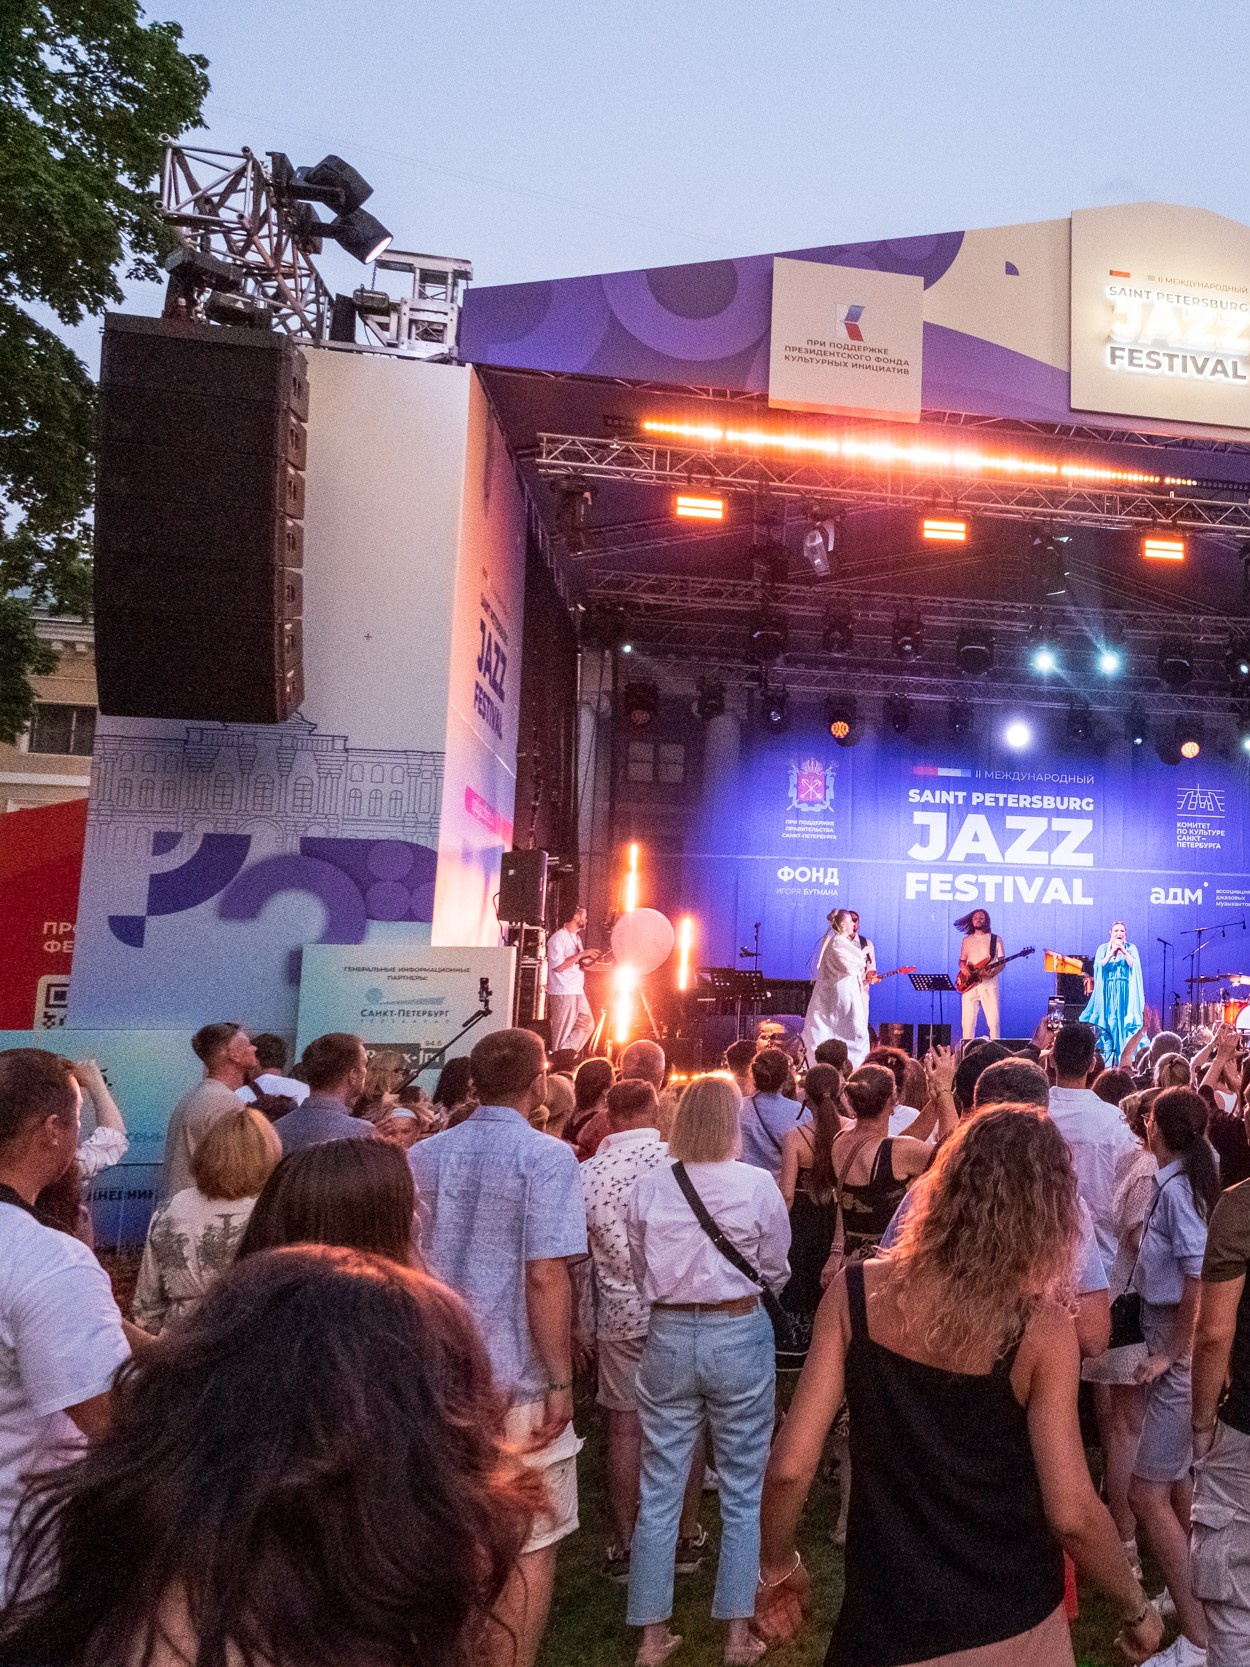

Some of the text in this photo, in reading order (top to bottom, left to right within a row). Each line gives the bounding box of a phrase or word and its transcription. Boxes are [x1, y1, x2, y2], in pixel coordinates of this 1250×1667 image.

[1165, 277, 1248, 294] МЕЖДУНАРОДНЫЙ
[1109, 286, 1249, 312] SAINT PETERSBURG
[784, 345, 910, 367] ПРЕЗИДЕНТСКОГО ФОНДА
[806, 339, 889, 355] ПРИ ПОДДЕРЖКЕ
[784, 354, 910, 375] КУЛЬТУРНЫХ ИНИЦИАТИВ
[1109, 346, 1247, 380] FESTIVAL
[985, 770, 1095, 784] МЕЖДУНАРОДНЫЙ
[908, 789, 1094, 811] SAINT PETERSBURG
[907, 811, 1094, 866] JAZZ
[777, 866, 839, 885] ФОНД
[803, 888, 838, 896] БУТМАНА
[905, 872, 1094, 905] FESTIVAL
